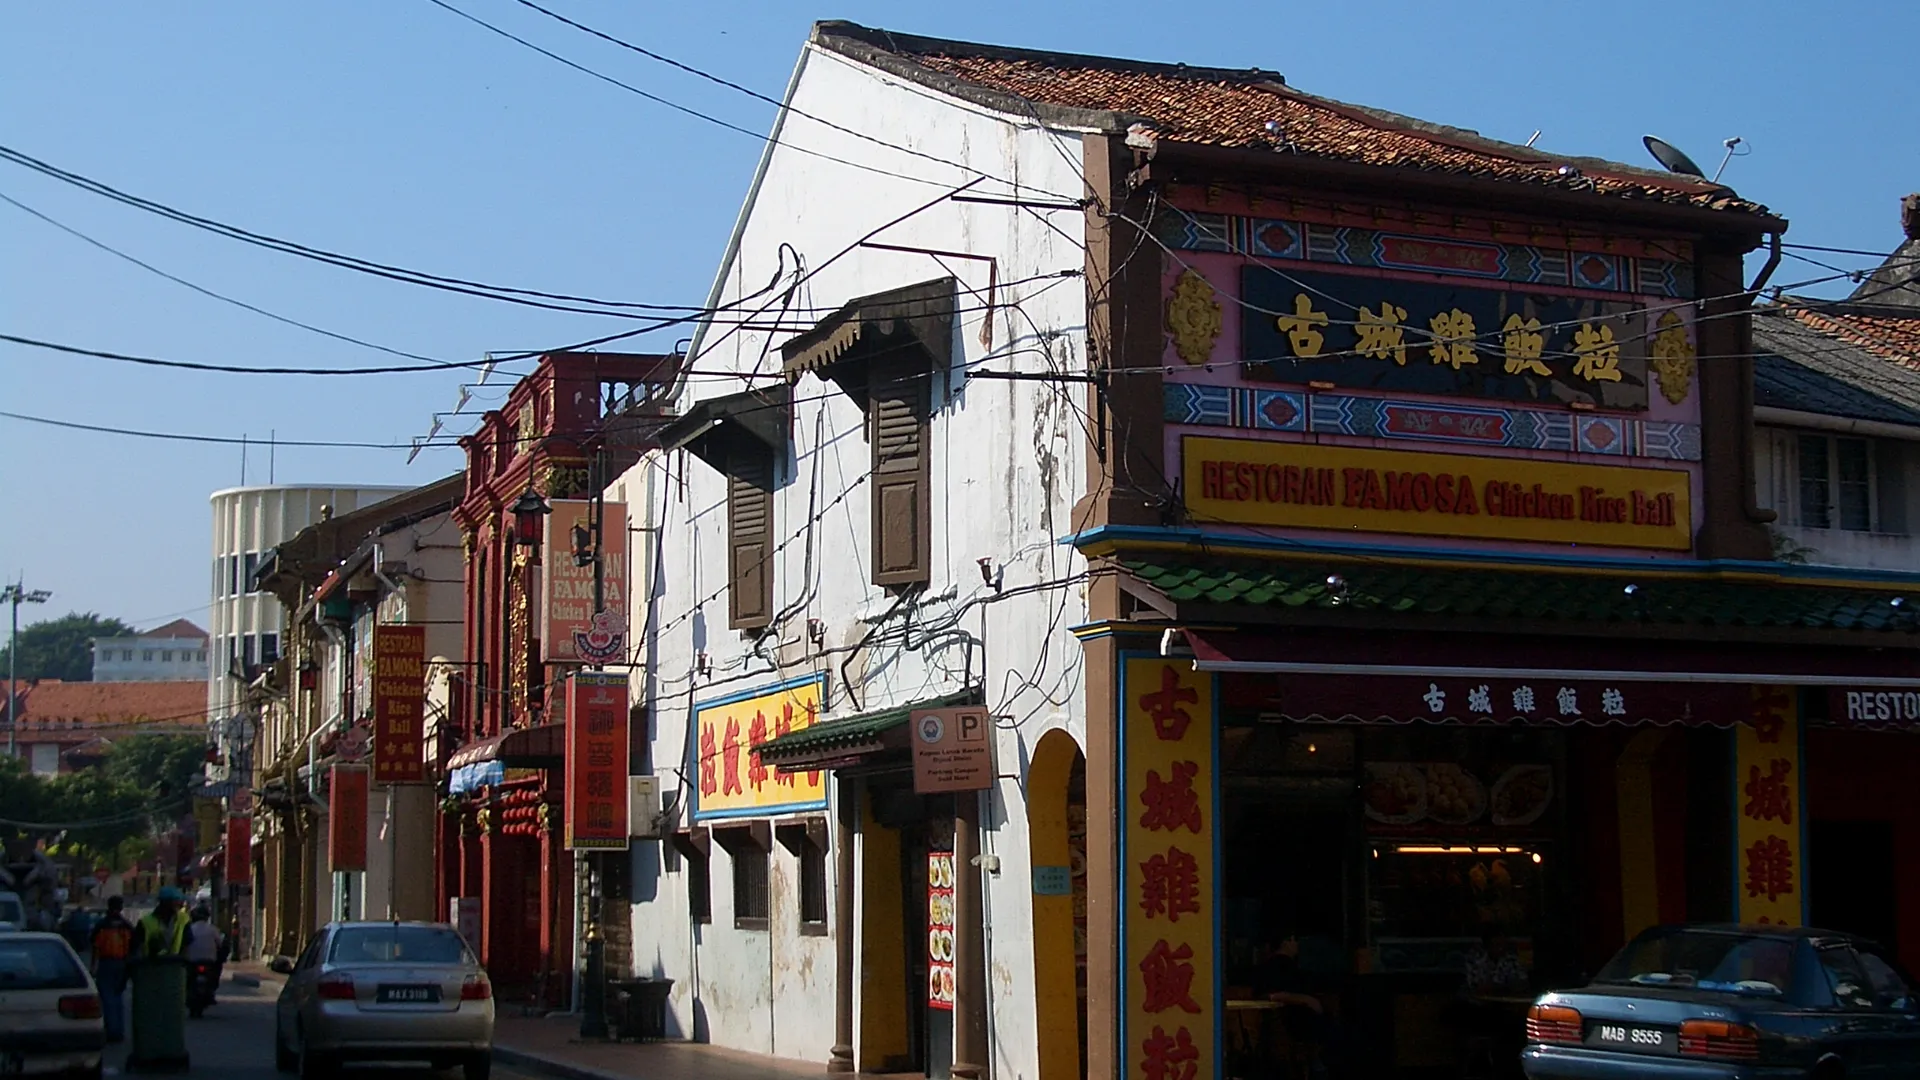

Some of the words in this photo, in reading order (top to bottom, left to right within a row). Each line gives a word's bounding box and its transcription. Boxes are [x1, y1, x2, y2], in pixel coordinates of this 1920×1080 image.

[1278, 292, 1623, 382] 古城雞飯粒
[1202, 461, 1335, 507] RESTORAN
[1342, 467, 1479, 516] FAMOSA
[1485, 480, 1575, 519] Chicken
[1580, 486, 1626, 524] Rice
[1632, 490, 1676, 527] Ball
[378, 657, 422, 677] FAMOSA
[378, 681, 422, 697] Chicken
[1423, 682, 1627, 716] 古城雞飯粒
[388, 700, 412, 715] Rice
[1847, 692, 1920, 721] RESTO
[388, 720, 411, 734] Ball
[961, 716, 978, 738] P
[1601, 1025, 1626, 1042] MAB
[1630, 1029, 1662, 1045] 9555
